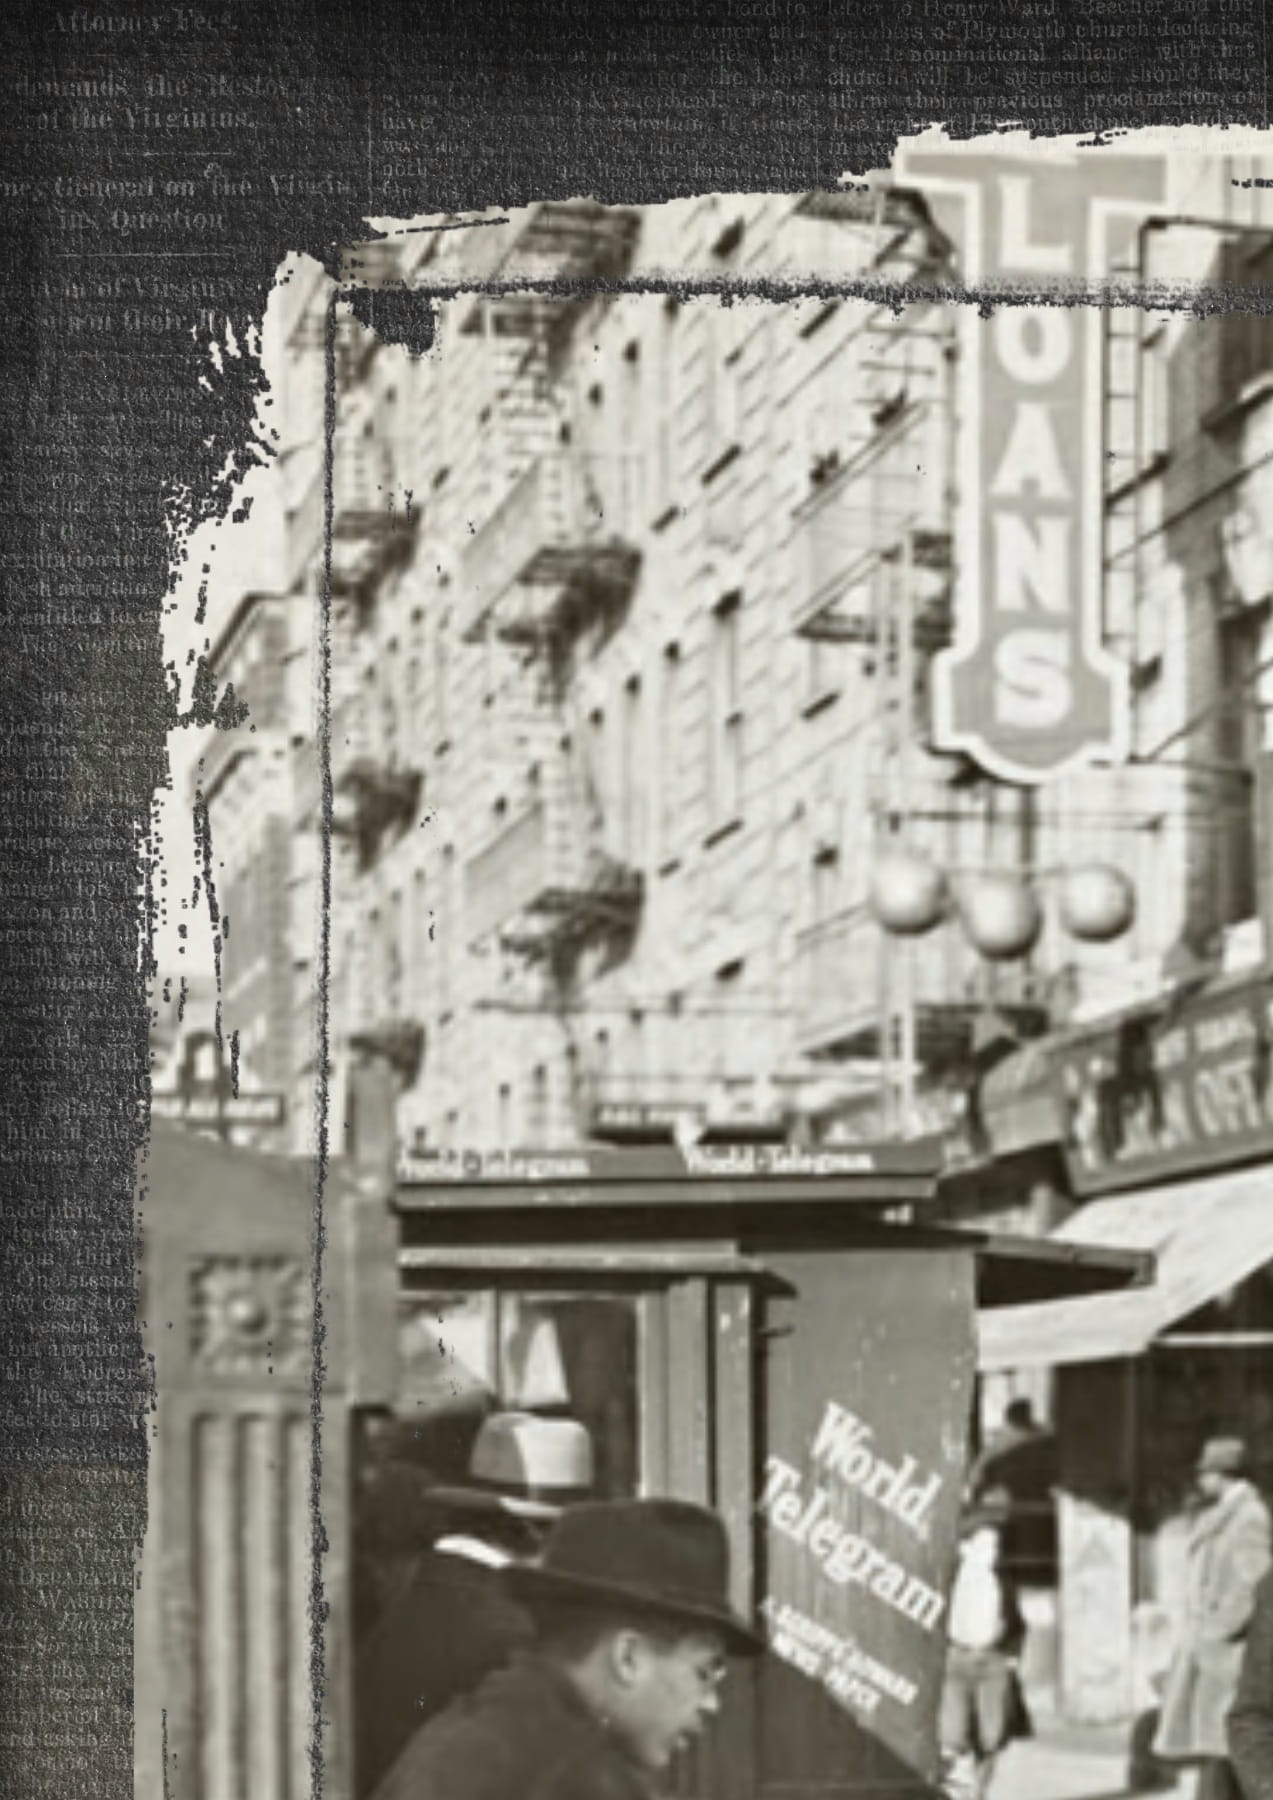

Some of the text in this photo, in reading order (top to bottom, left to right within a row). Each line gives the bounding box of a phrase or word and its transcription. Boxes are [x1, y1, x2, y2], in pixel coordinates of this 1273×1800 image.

[992, 175, 1072, 727] LOANS
[762, 1452, 945, 1632] Telegram
[810, 1400, 943, 1541] World
